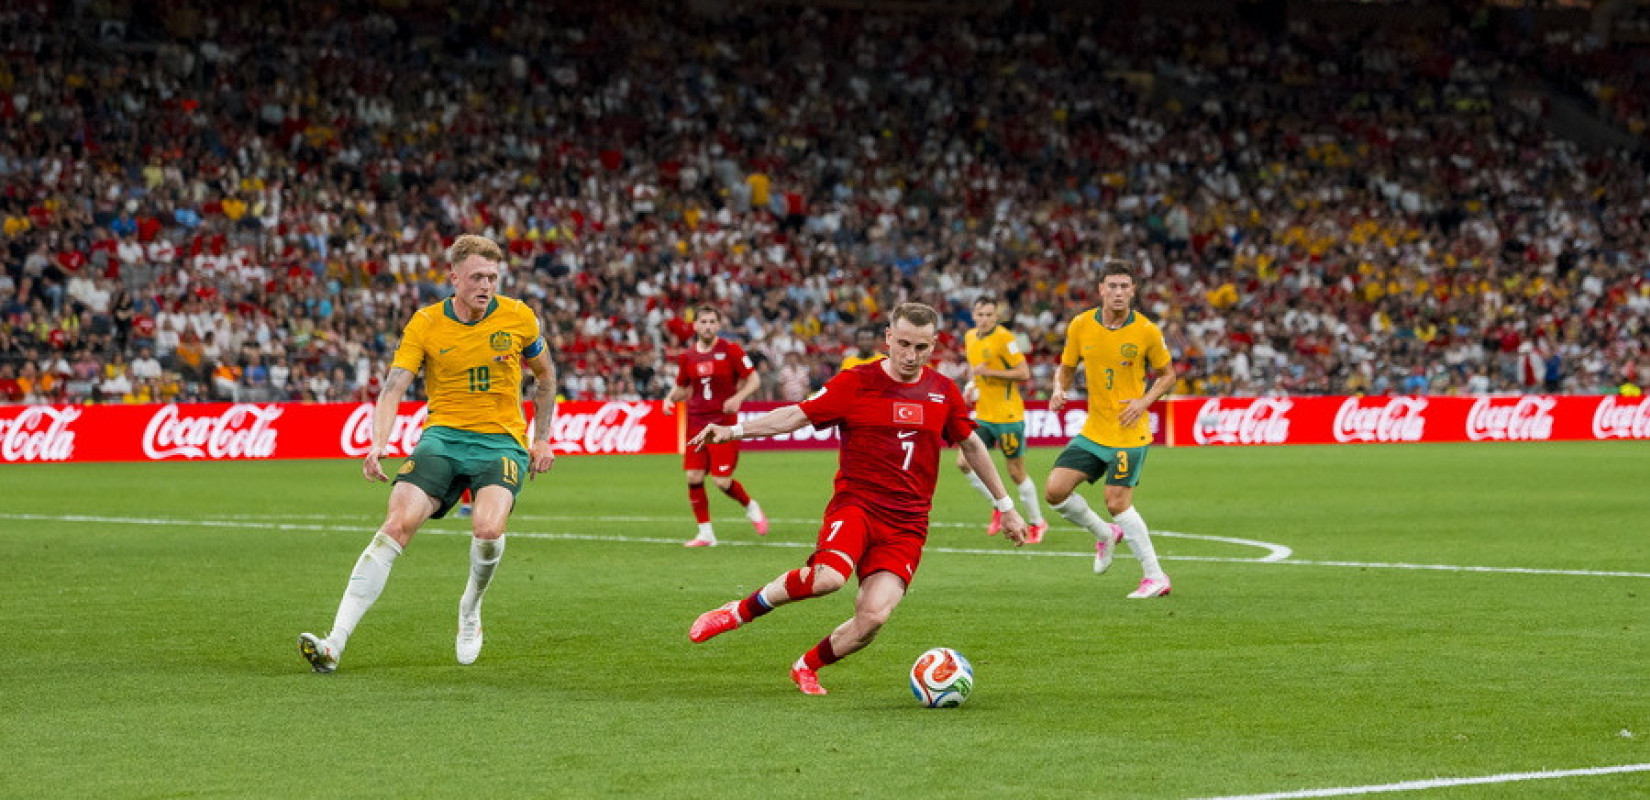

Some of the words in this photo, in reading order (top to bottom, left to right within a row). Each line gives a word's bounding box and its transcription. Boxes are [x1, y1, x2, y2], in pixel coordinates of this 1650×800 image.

[469, 365, 491, 392] 19
[1104, 368, 1114, 390] 3
[142, 403, 284, 459] Coca-Cola
[1023, 409, 1062, 437] IFA
[1193, 397, 1294, 445] Coca-Cola
[1333, 397, 1429, 442] Coca-Cola
[1465, 396, 1558, 440] Coca-Cola
[1592, 395, 1650, 440] Coca-C
[902, 441, 915, 470] 7
[1116, 451, 1128, 472] 3
[826, 520, 845, 541] 7
